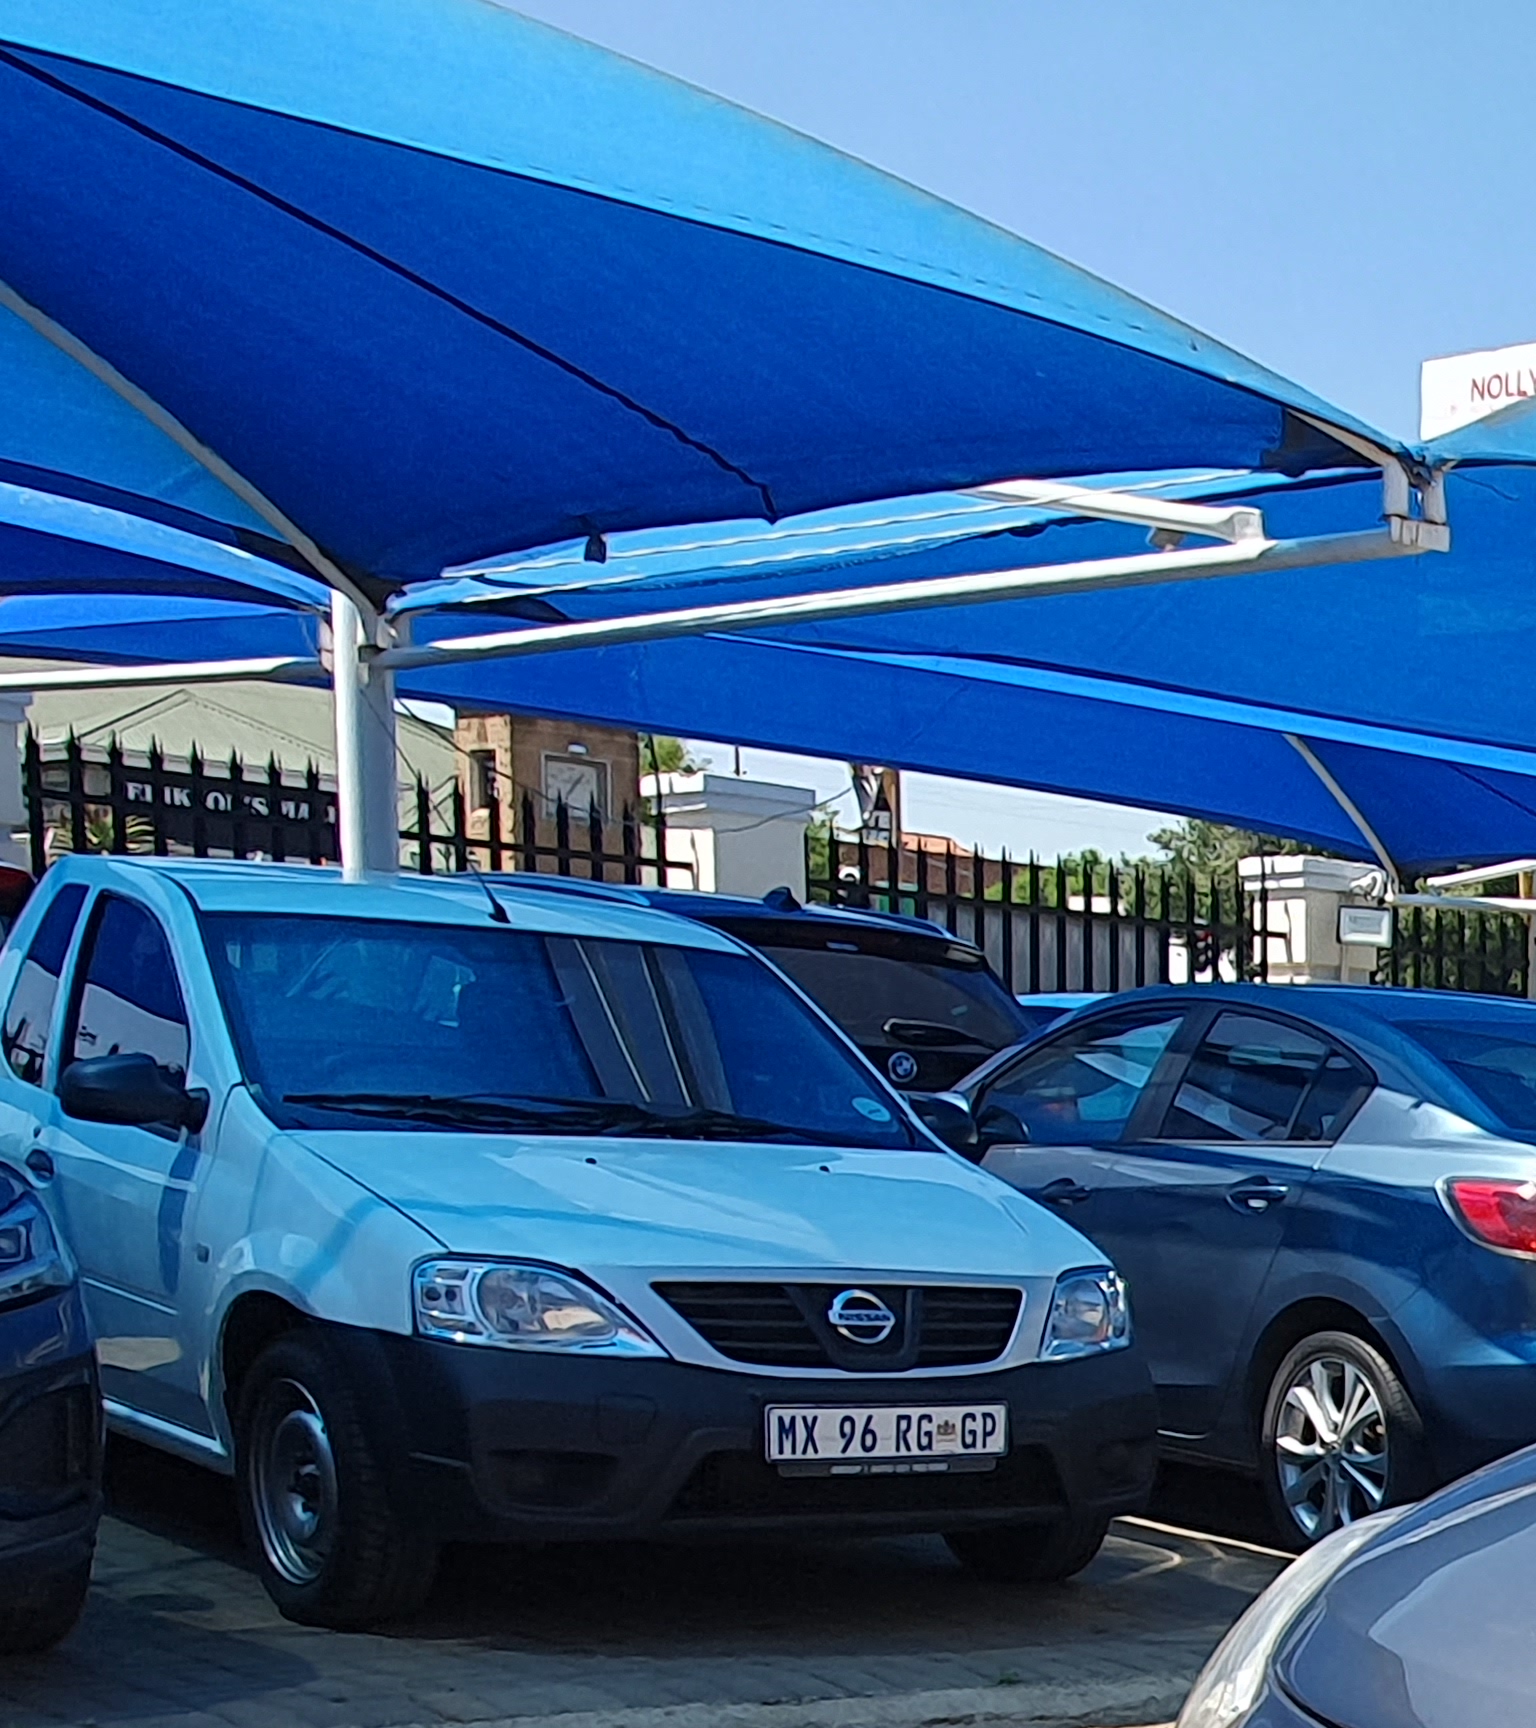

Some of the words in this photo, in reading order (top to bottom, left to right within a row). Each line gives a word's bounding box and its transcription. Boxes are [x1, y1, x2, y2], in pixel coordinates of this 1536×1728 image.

[777, 1415, 819, 1455] MX
[839, 1414, 878, 1454] 96
[895, 1413, 933, 1453] RG
[961, 1412, 997, 1450] GP
